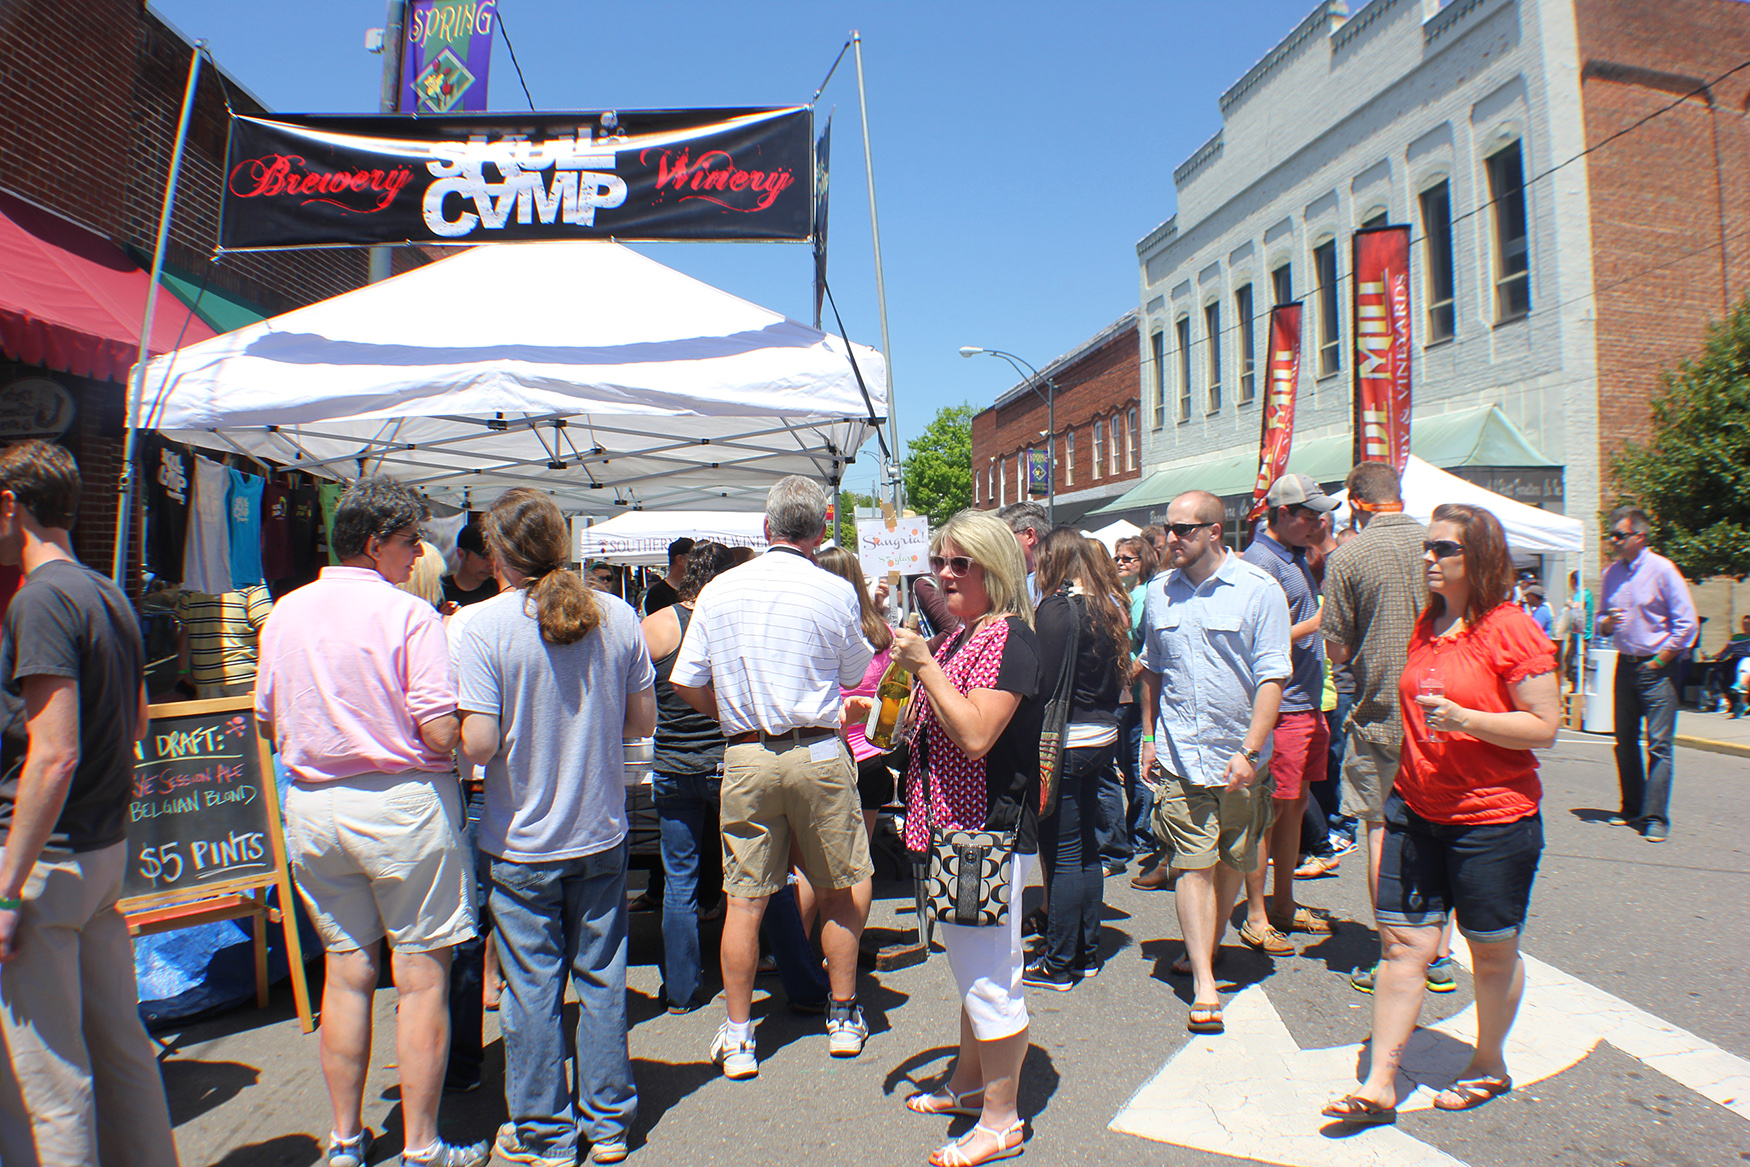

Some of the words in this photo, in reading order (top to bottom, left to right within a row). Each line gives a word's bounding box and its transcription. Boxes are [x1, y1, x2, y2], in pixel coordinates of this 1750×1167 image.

[409, 0, 496, 48] SPRING
[229, 154, 415, 214] Brewery
[421, 170, 628, 237] CAMP
[640, 147, 795, 213] Winery
[1357, 270, 1394, 379] MILL
[1392, 273, 1410, 400] VINEYARDS
[609, 537, 676, 553] SOUTHER
[731, 535, 768, 548] WINE
[862, 531, 925, 551] Sangria!
[155, 725, 225, 758] DRAFT:
[129, 789, 201, 822] BELGIAN
[203, 784, 258, 807] BLOND
[132, 772, 160, 798] YE
[158, 767, 212, 795] SESSION
[216, 763, 246, 784] ALE
[138, 841, 184, 888] $5
[190, 830, 266, 870] PINTS
